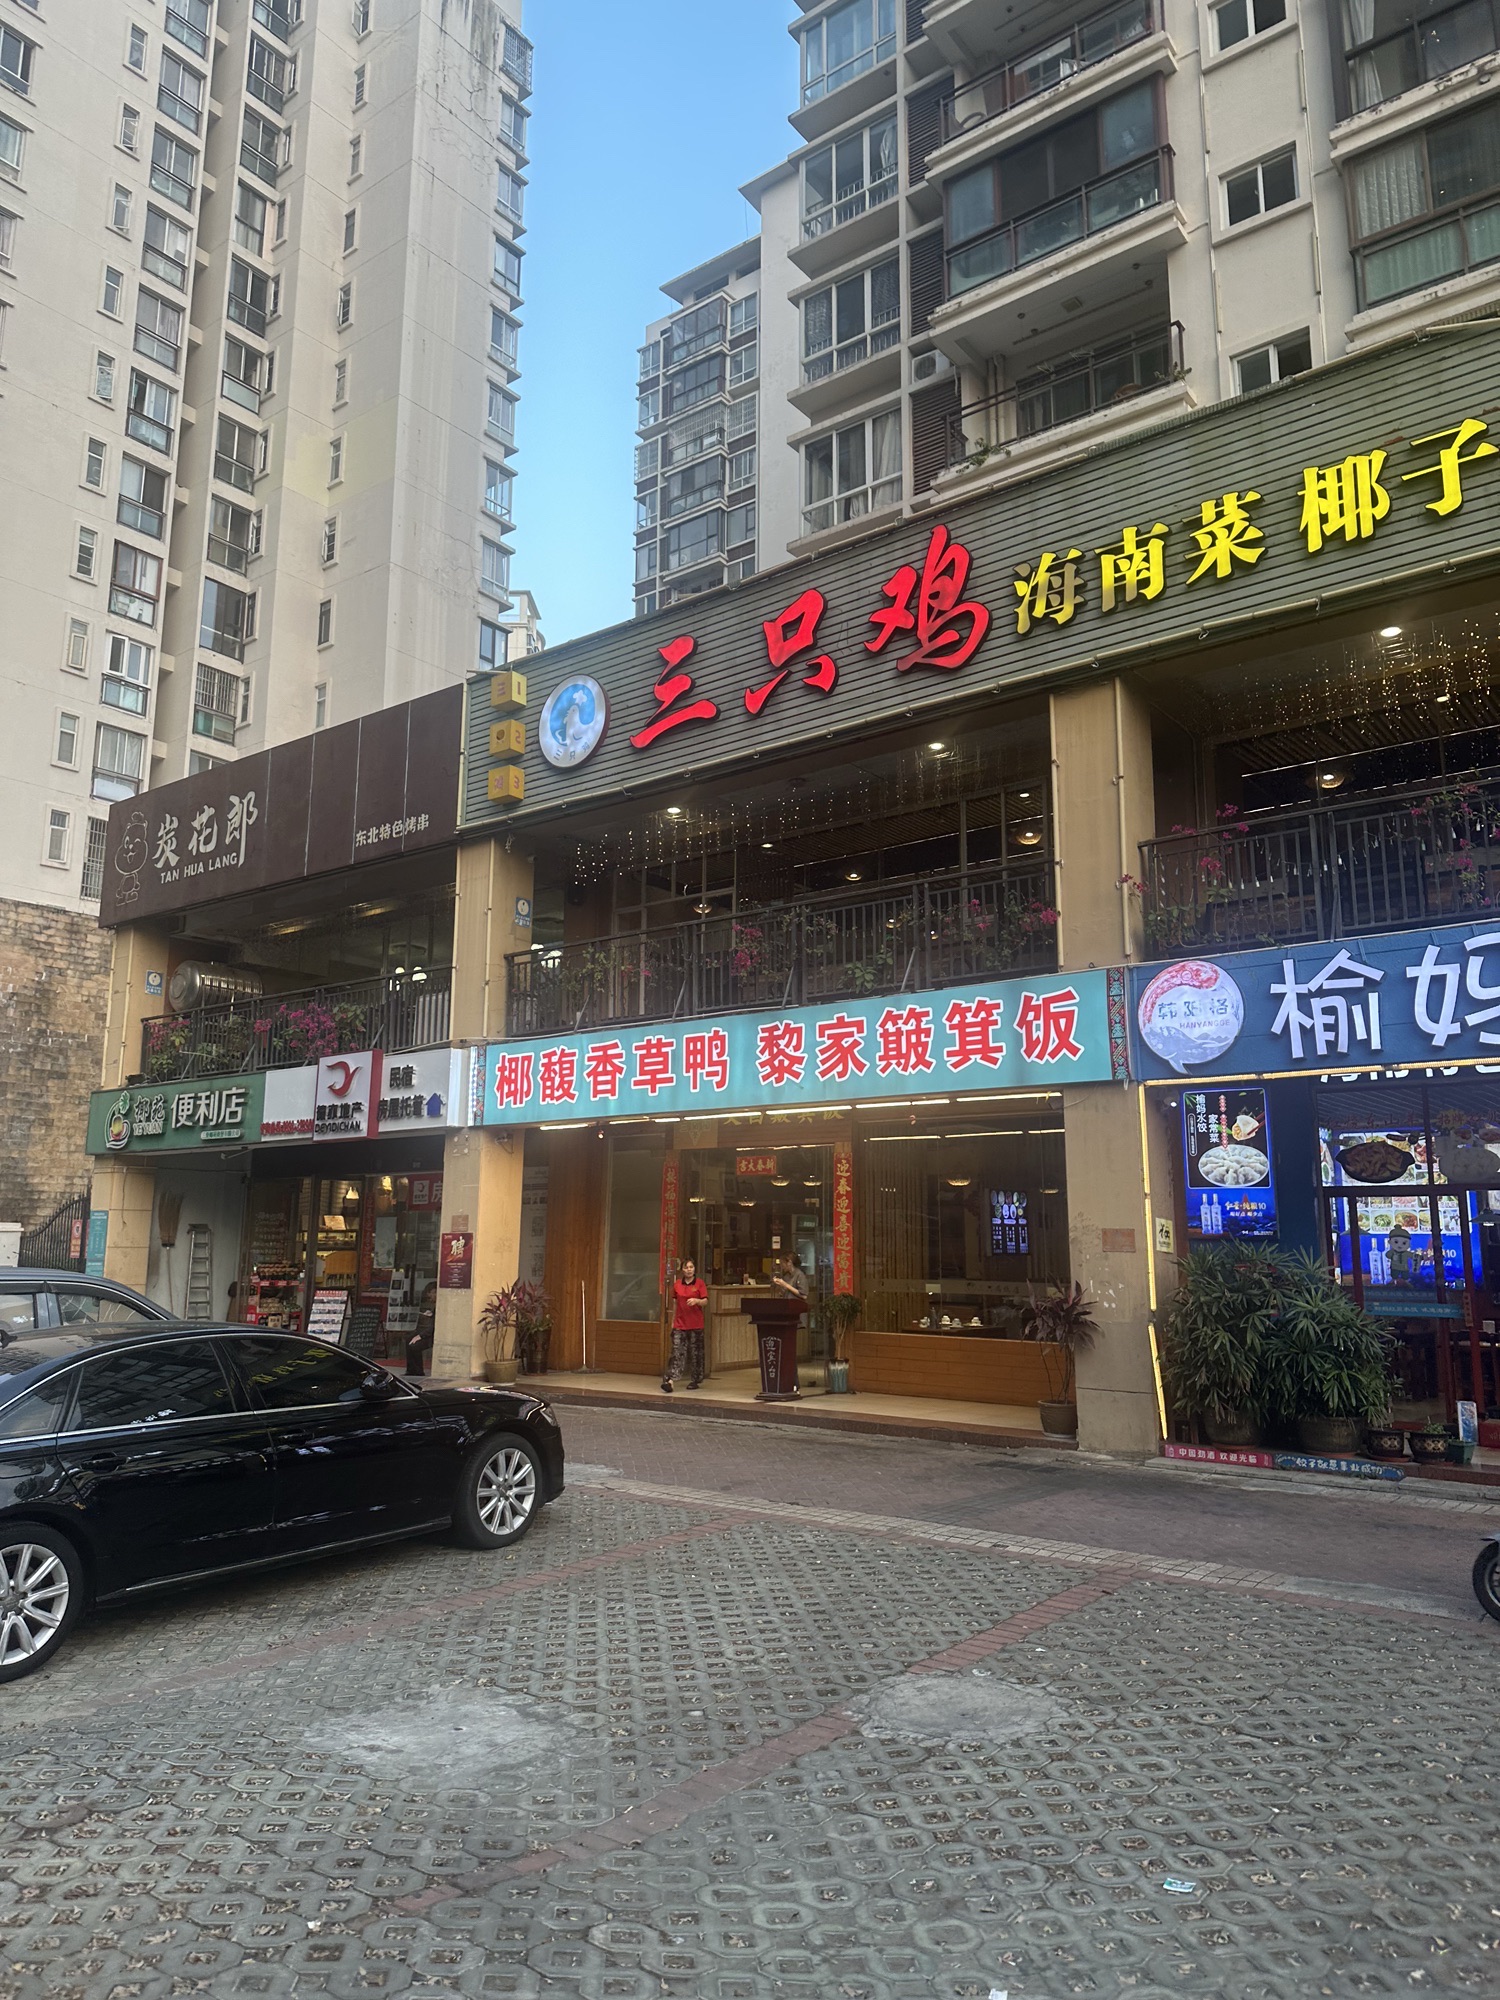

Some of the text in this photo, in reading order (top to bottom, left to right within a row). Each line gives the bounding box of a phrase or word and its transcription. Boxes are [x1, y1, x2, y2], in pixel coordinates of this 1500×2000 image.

[630, 418, 1499, 749] 三只鸡 海南菜 椰子
[152, 791, 258, 868] 炭花郎
[356, 813, 429, 847] 东北特色烤串
[160, 852, 238, 884] TAN HUA LANG
[495, 985, 1084, 1108] 椰馥香草鸭 黎家簸箕饭
[389, 1064, 415, 1089] 民宿
[171, 1087, 246, 1129] 便利店
[1208, 1114, 1220, 1143] 家常菜
[451, 1236, 465, 1258] 聘
[766, 1340, 776, 1378] 迎宾台
[1179, 1448, 1257, 1464] 中国劲酒 欢迎光临
